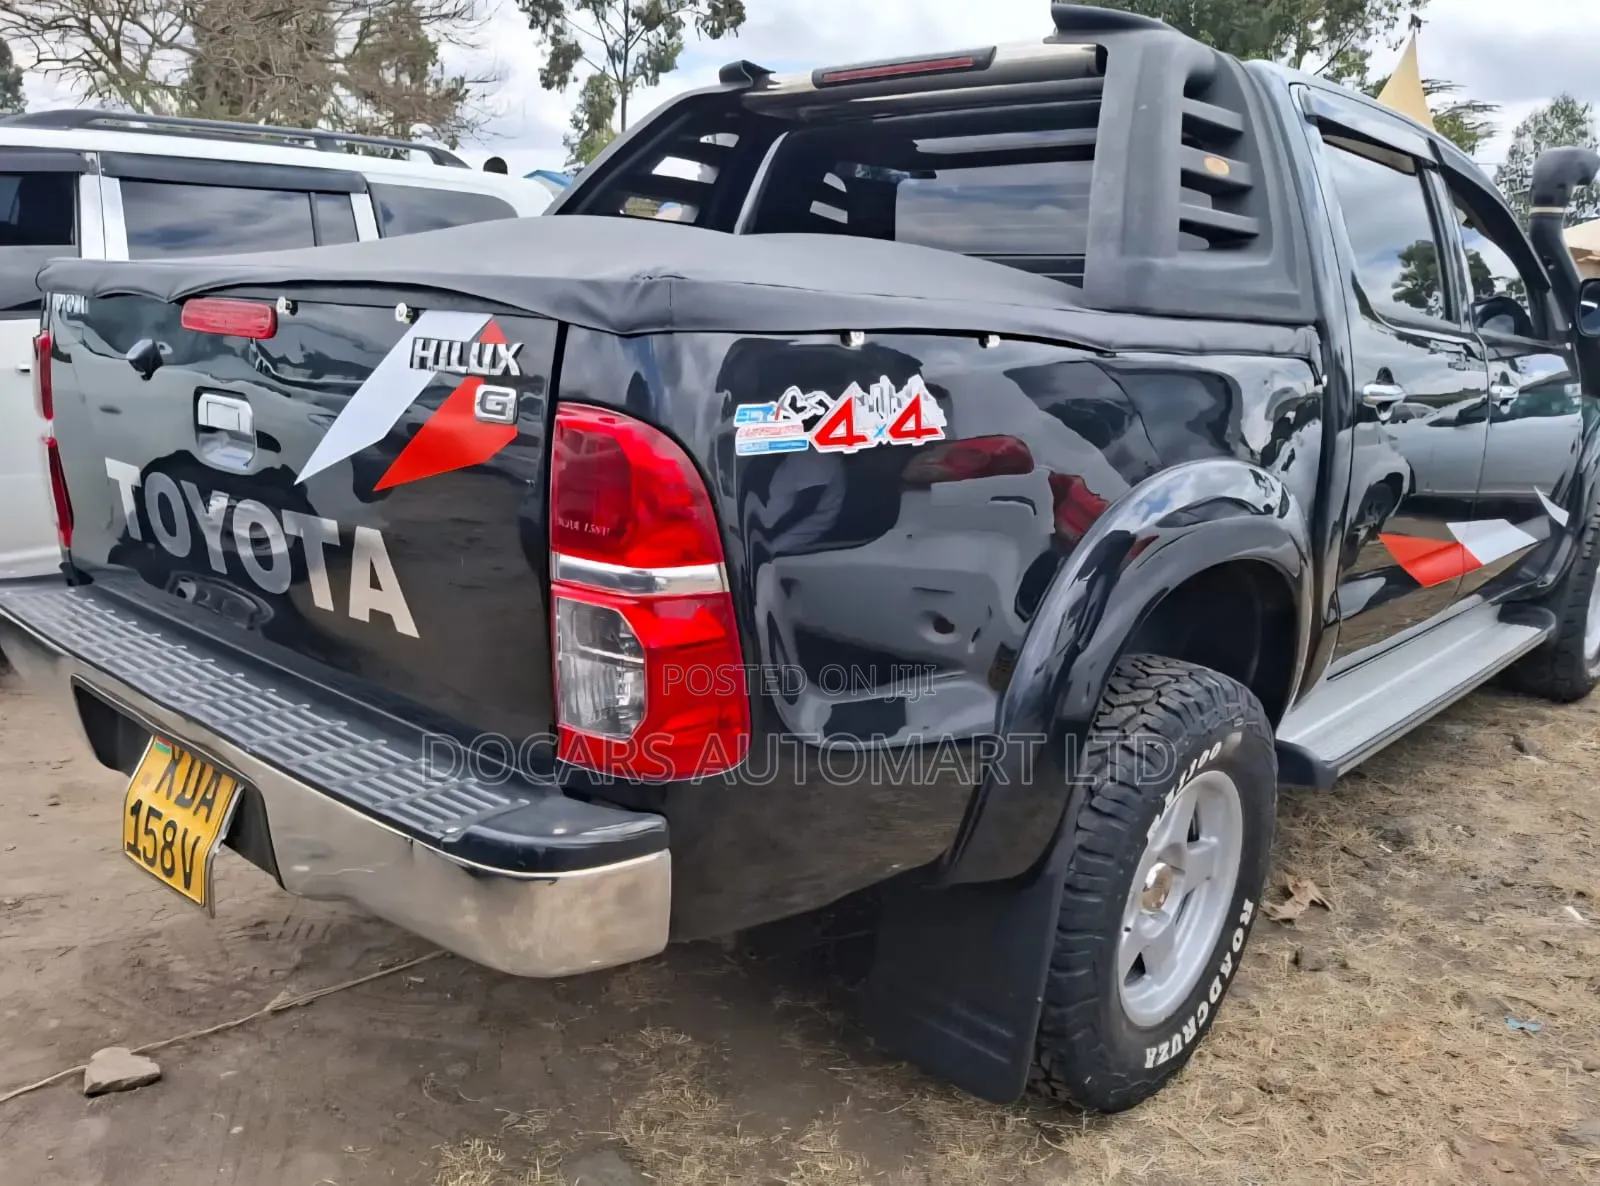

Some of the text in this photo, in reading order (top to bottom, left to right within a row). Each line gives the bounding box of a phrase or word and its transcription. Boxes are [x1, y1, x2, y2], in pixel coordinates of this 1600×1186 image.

[410, 337, 524, 376] HILUX
[478, 388, 510, 419] G
[105, 457, 420, 638] TOYOTA
[127, 798, 201, 891] 158V
[1144, 898, 1254, 1069] ROADCRUZA
